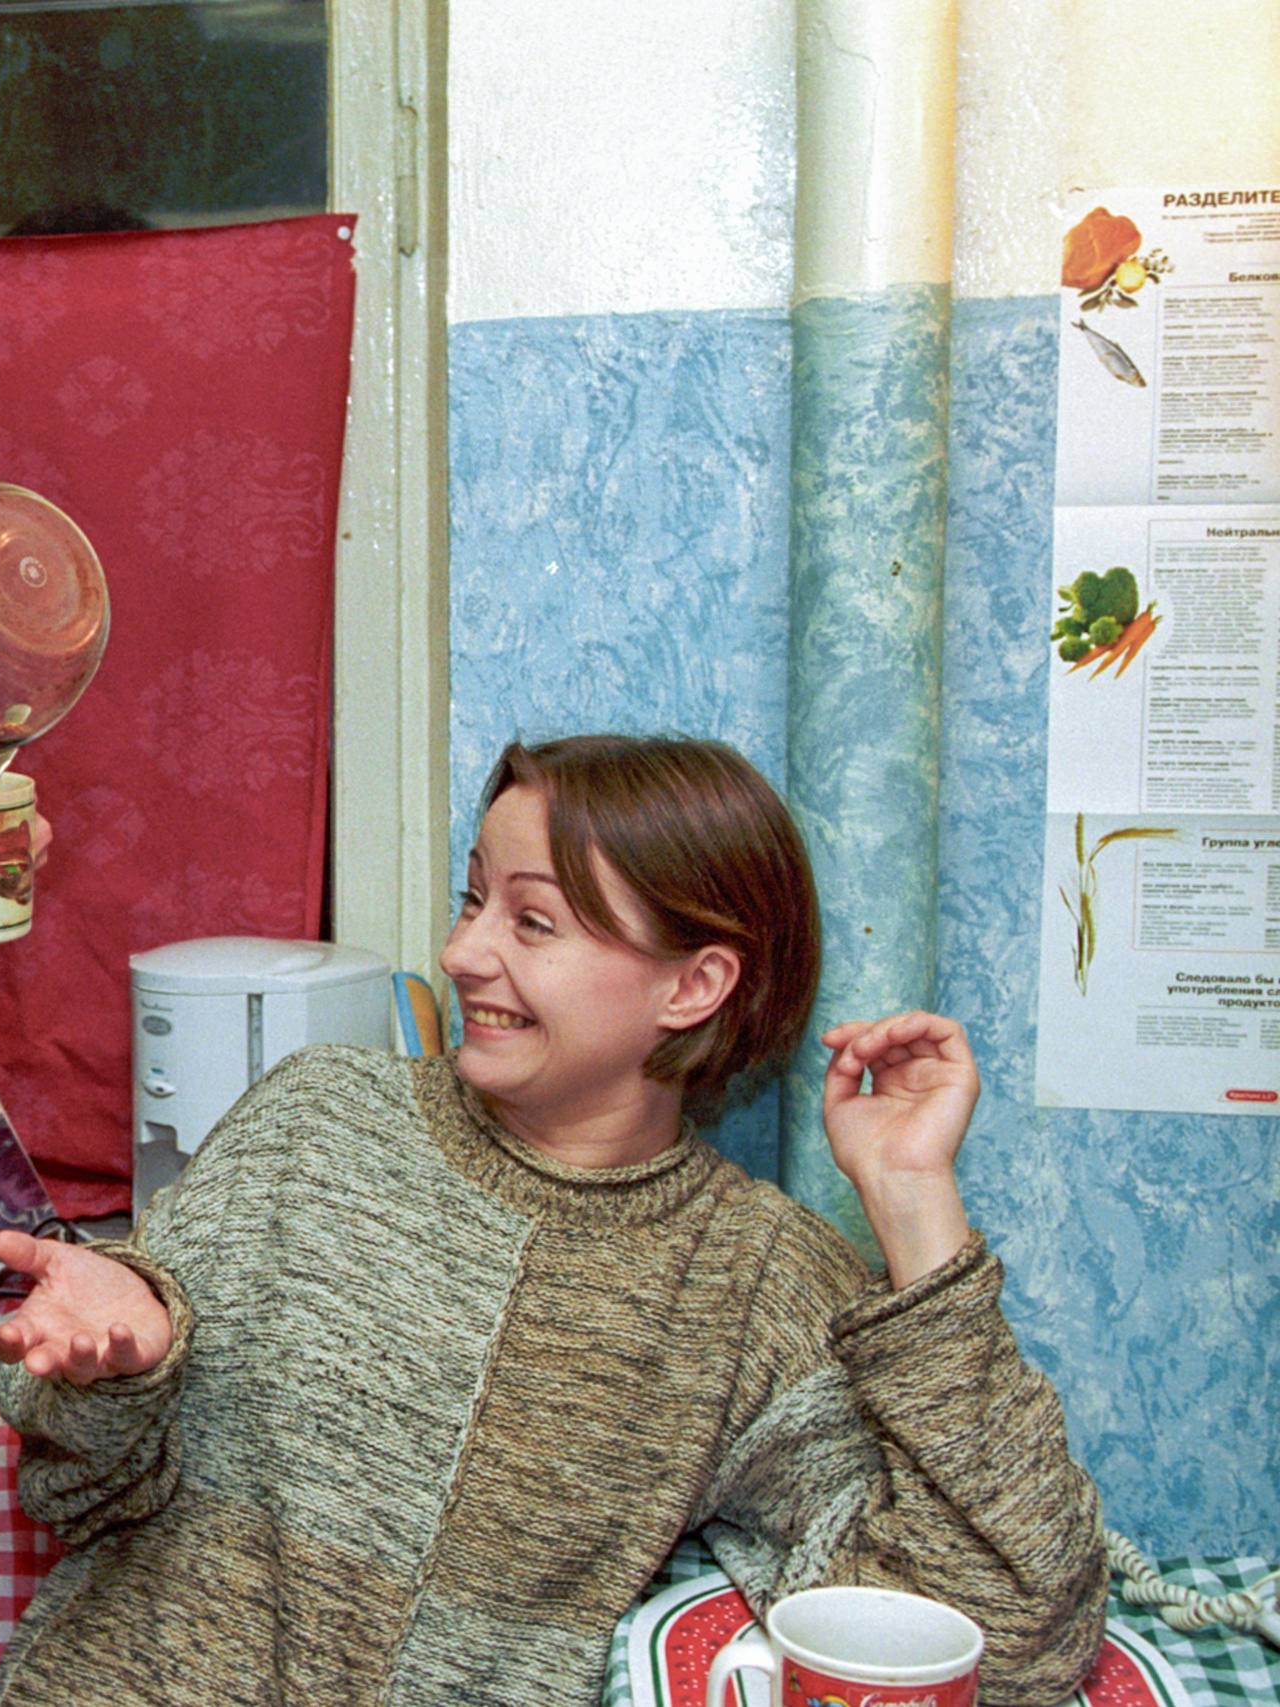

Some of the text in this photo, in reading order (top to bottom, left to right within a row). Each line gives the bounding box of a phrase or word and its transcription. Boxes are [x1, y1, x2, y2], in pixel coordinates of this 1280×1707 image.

[1163, 190, 1280, 208] РАЗДЕЛИТЕ
[1229, 272, 1280, 283] Белков
[1201, 836, 1250, 849] Группа
[1175, 971, 1275, 985] Следовало бы
[1166, 984, 1263, 996] употребления
